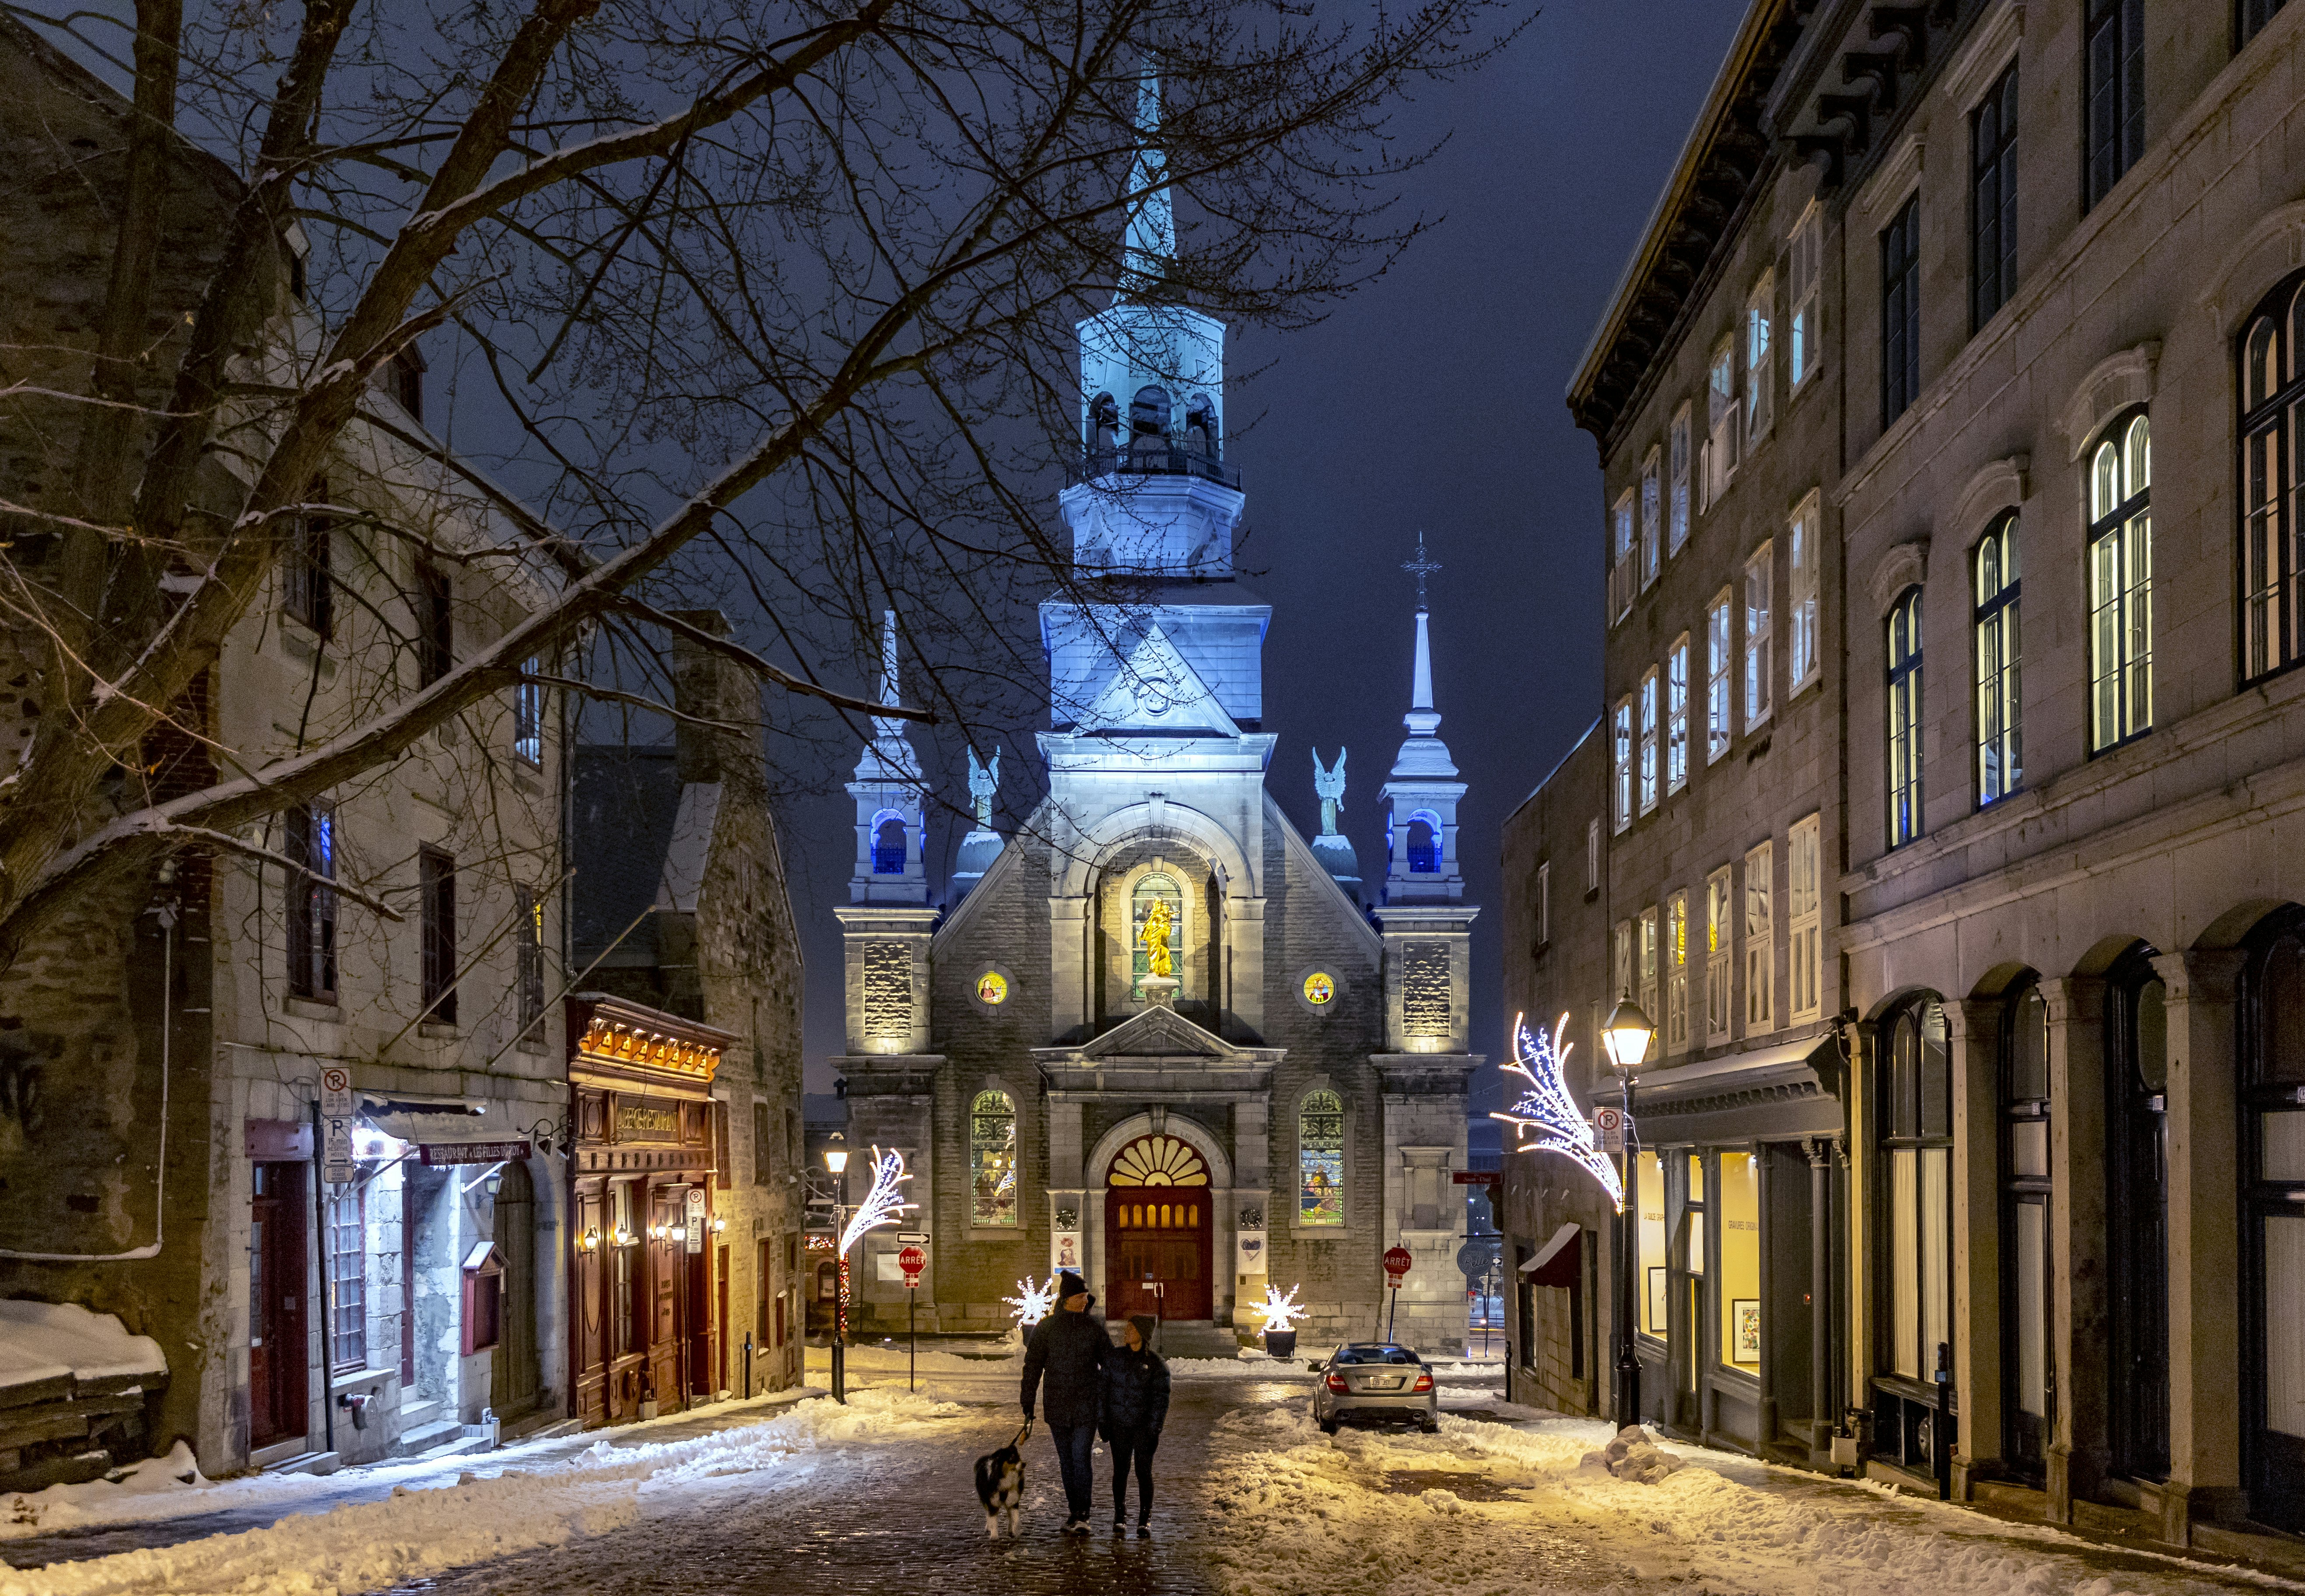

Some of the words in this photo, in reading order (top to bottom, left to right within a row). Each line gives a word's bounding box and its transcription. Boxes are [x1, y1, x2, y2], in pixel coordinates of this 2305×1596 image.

[430, 1147, 468, 1160] RESTAURANT
[483, 1145, 500, 1157] FILLES
[900, 1255, 925, 1264] ARRÊT
[1384, 1256, 1410, 1267] ARRÊT
